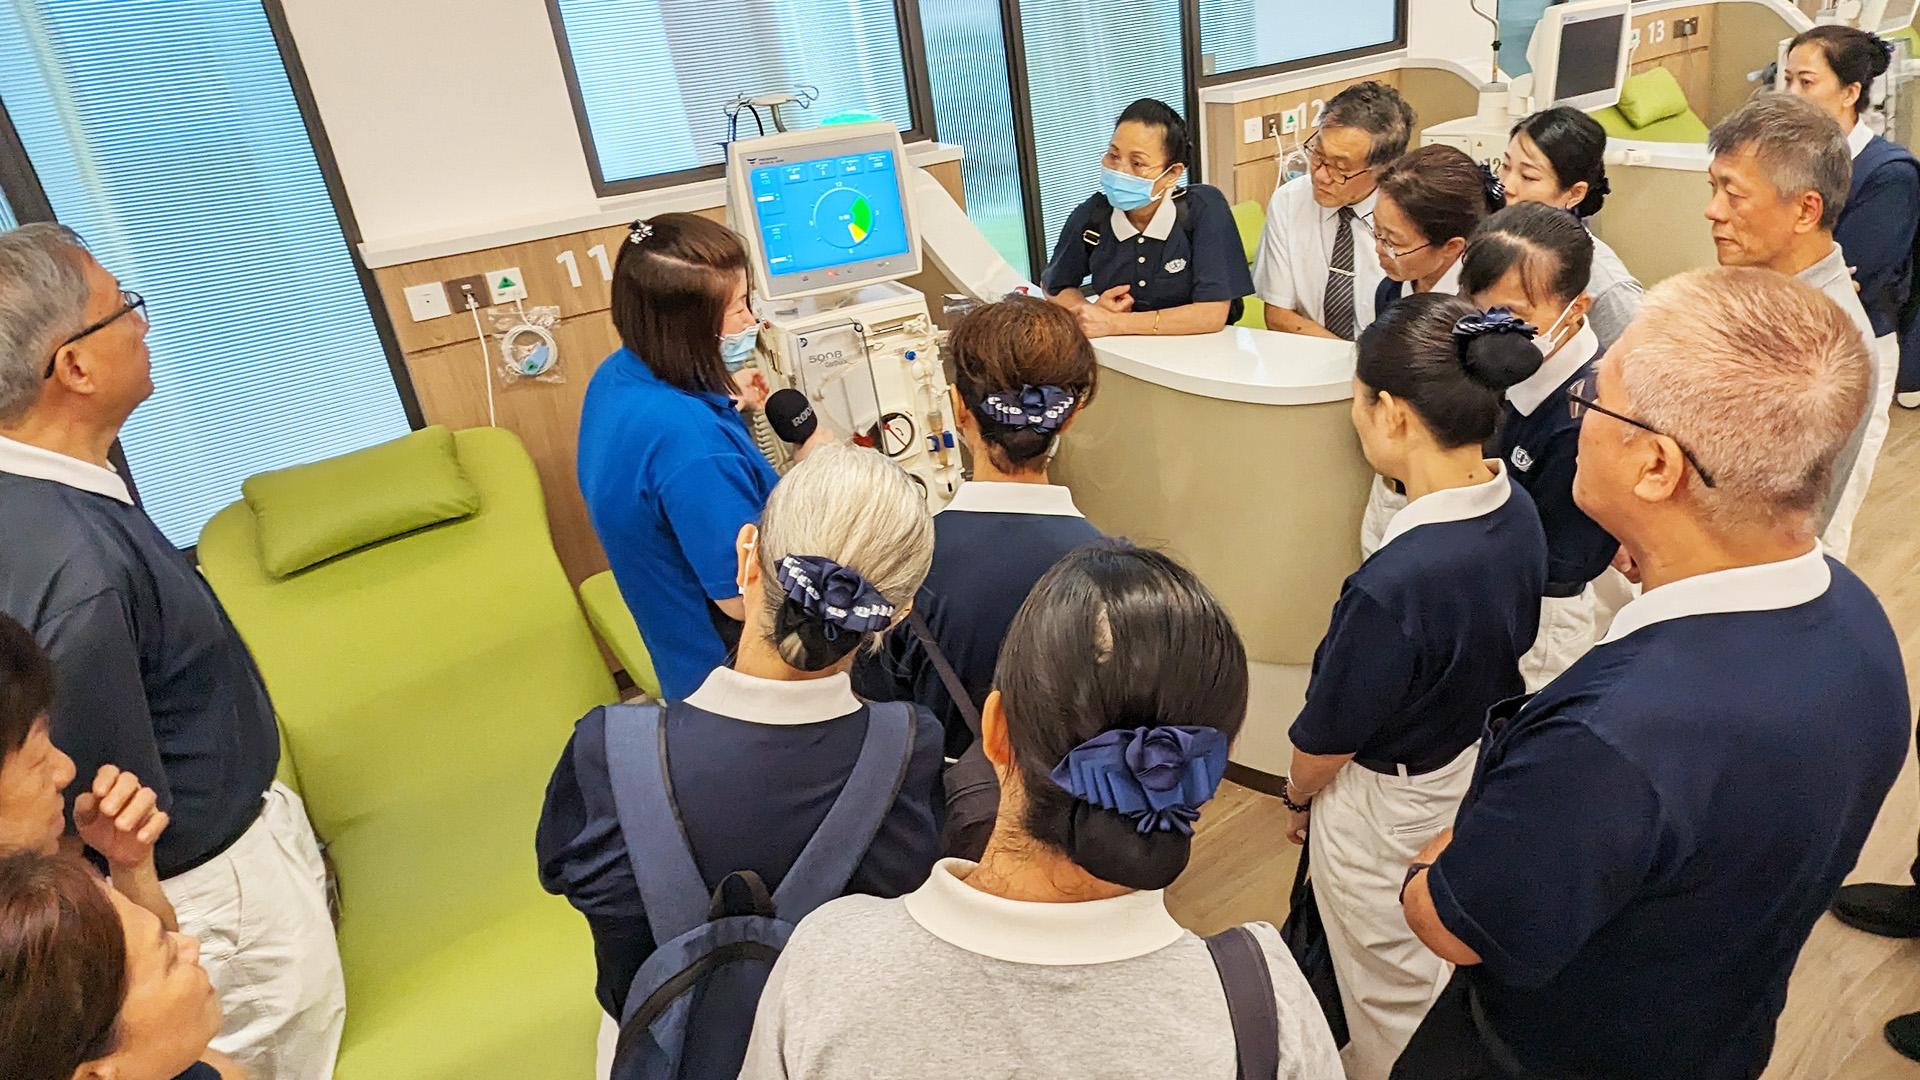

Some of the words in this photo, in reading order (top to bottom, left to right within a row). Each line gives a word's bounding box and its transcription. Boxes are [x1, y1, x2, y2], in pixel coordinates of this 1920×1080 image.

[1647, 20, 1665, 44] 13
[1297, 99, 1325, 130] 12
[556, 244, 614, 288] 11
